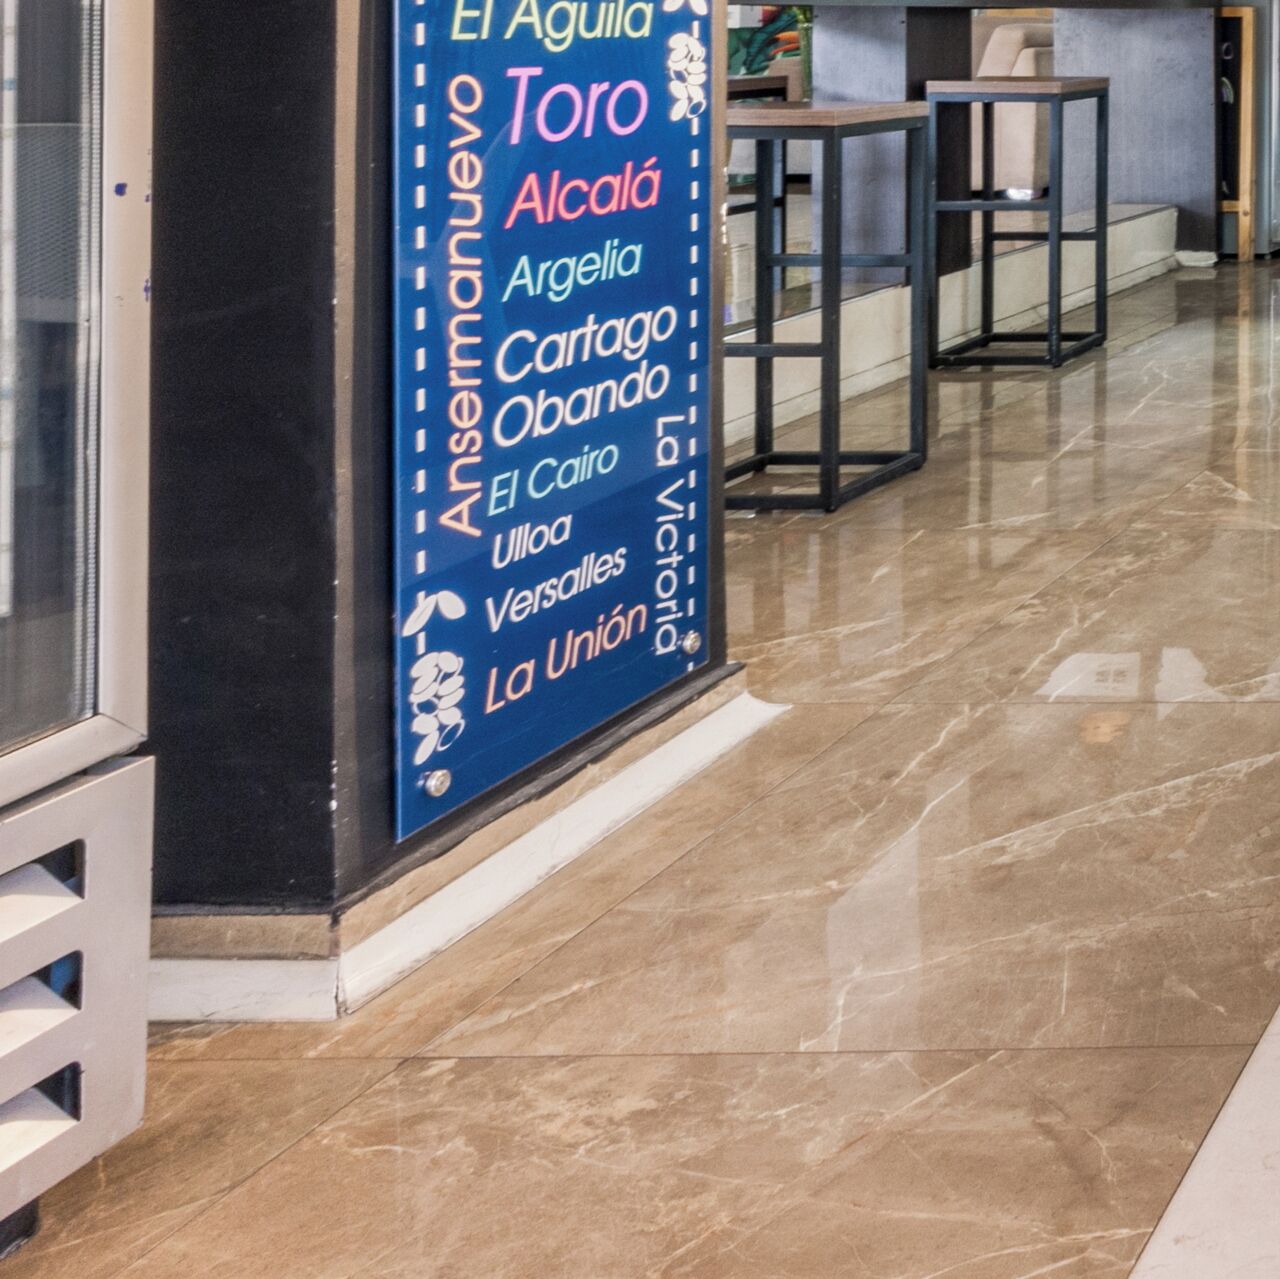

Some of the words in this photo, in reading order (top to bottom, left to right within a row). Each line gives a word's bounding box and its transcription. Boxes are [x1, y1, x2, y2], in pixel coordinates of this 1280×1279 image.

[505, 66, 650, 146] Toro
[503, 156, 662, 230] Alcalá
[438, 73, 484, 537] Ansermanuevo
[501, 237, 643, 303] Argelia
[494, 304, 678, 384] Cartago
[491, 359, 670, 448] Obando
[654, 414, 685, 468] La
[486, 470, 518, 519] El
[527, 442, 619, 500] Cairo
[491, 513, 574, 571] Ulloa
[654, 477, 685, 657] Victoria
[484, 545, 628, 634] Versalles
[483, 658, 535, 715] La
[546, 601, 649, 682] Unión
